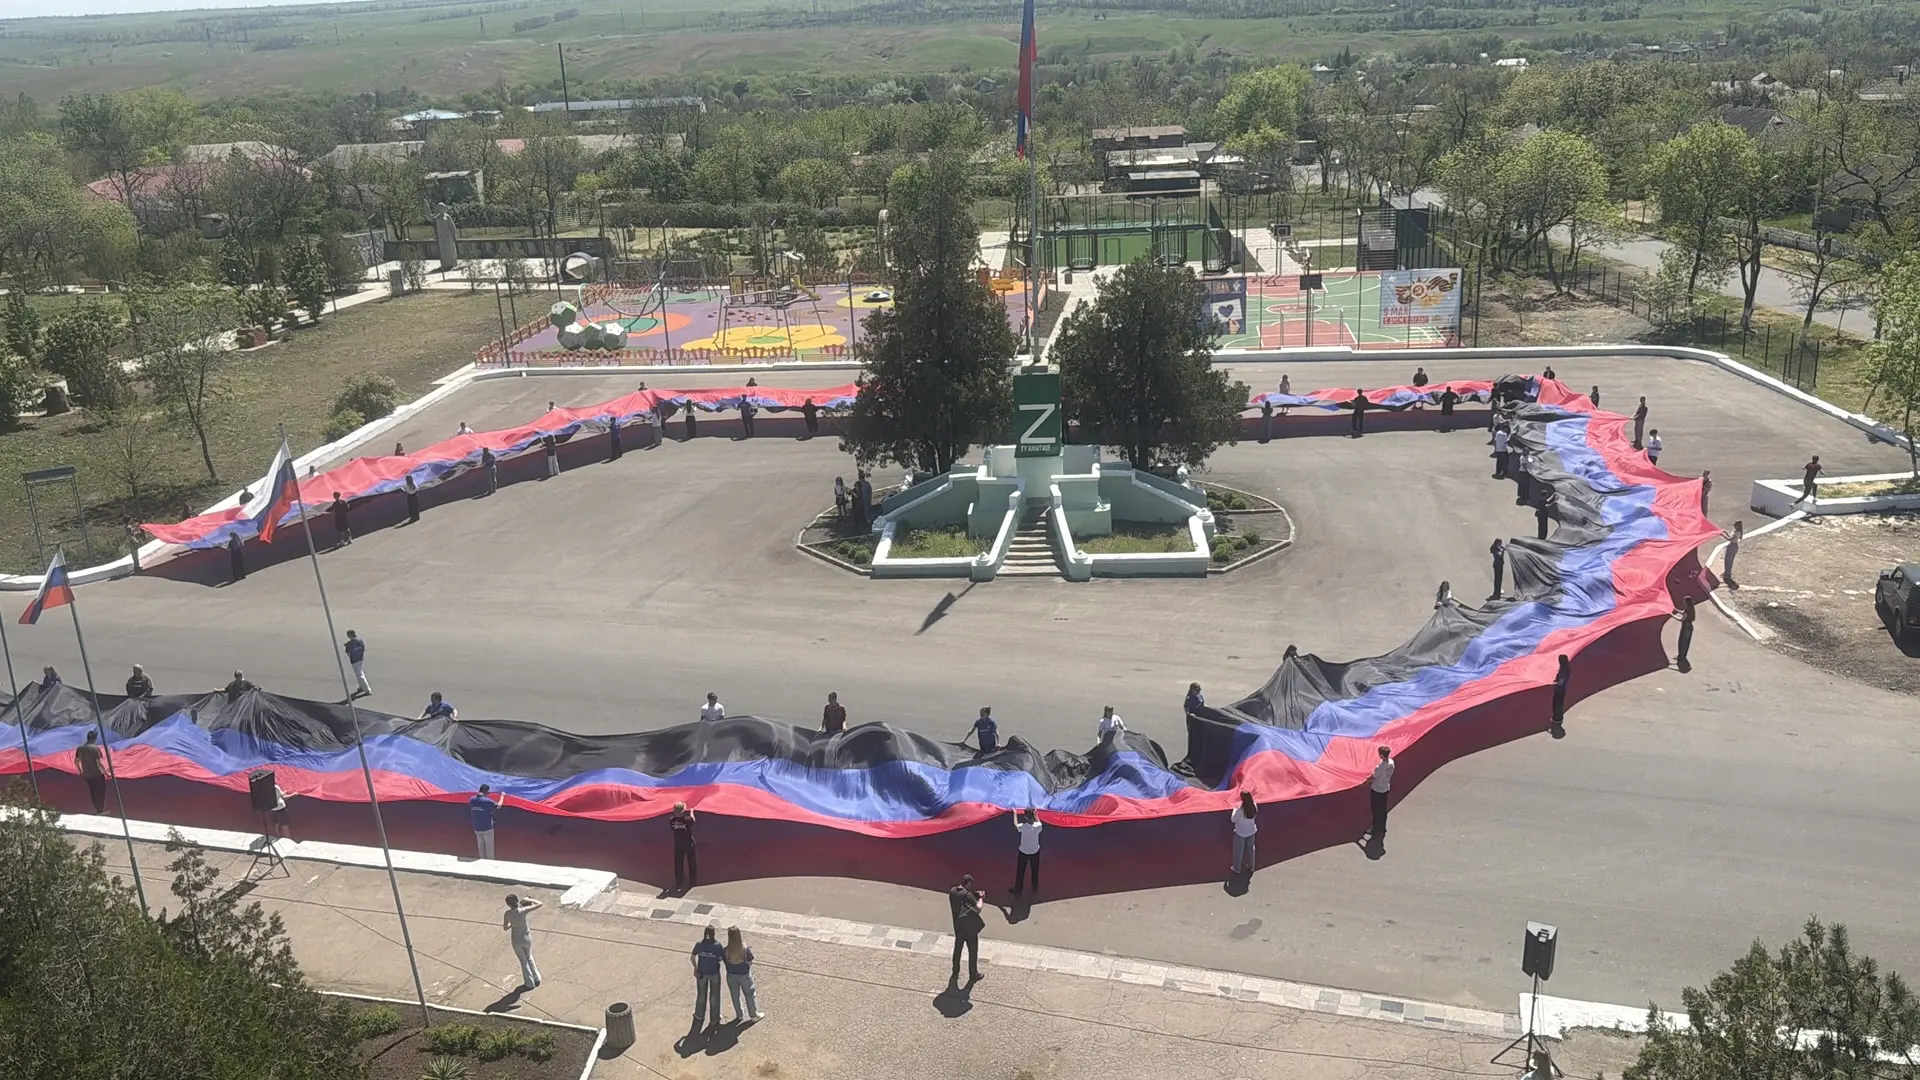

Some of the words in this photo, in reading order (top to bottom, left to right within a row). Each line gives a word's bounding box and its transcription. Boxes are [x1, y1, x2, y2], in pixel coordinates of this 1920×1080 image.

[1384, 307, 1389, 316] 9
[1391, 307, 1408, 316] МАЯ
[1019, 404, 1056, 443] Z
